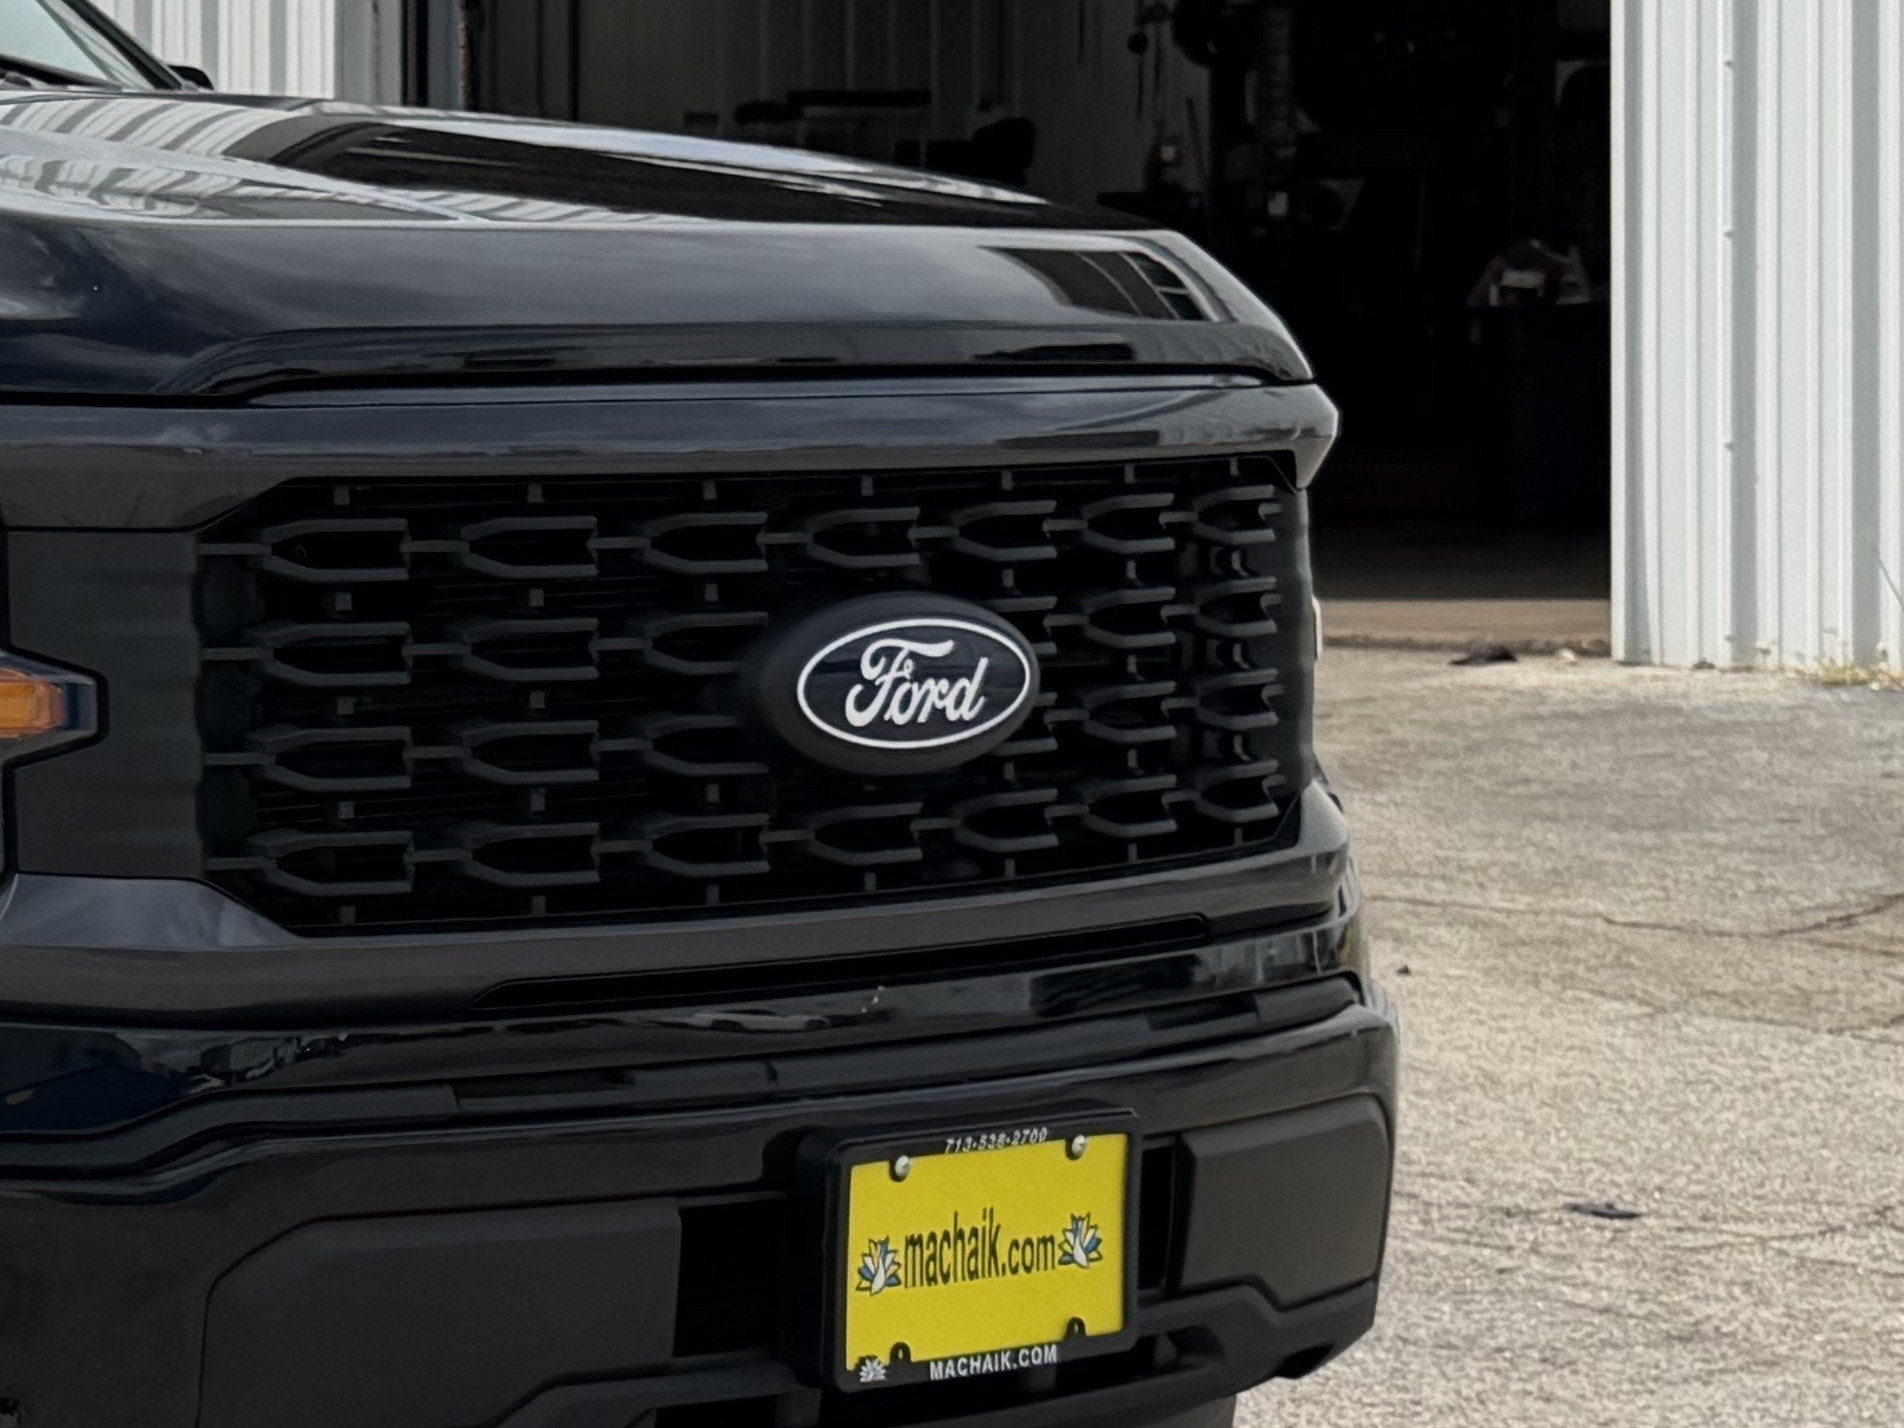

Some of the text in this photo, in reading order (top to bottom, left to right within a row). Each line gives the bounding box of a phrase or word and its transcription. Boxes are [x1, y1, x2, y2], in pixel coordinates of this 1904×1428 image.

[844, 636, 991, 728] Ford
[903, 1206, 1058, 1290] machaik.com
[928, 1343, 1059, 1382] MACHAIK.COM
